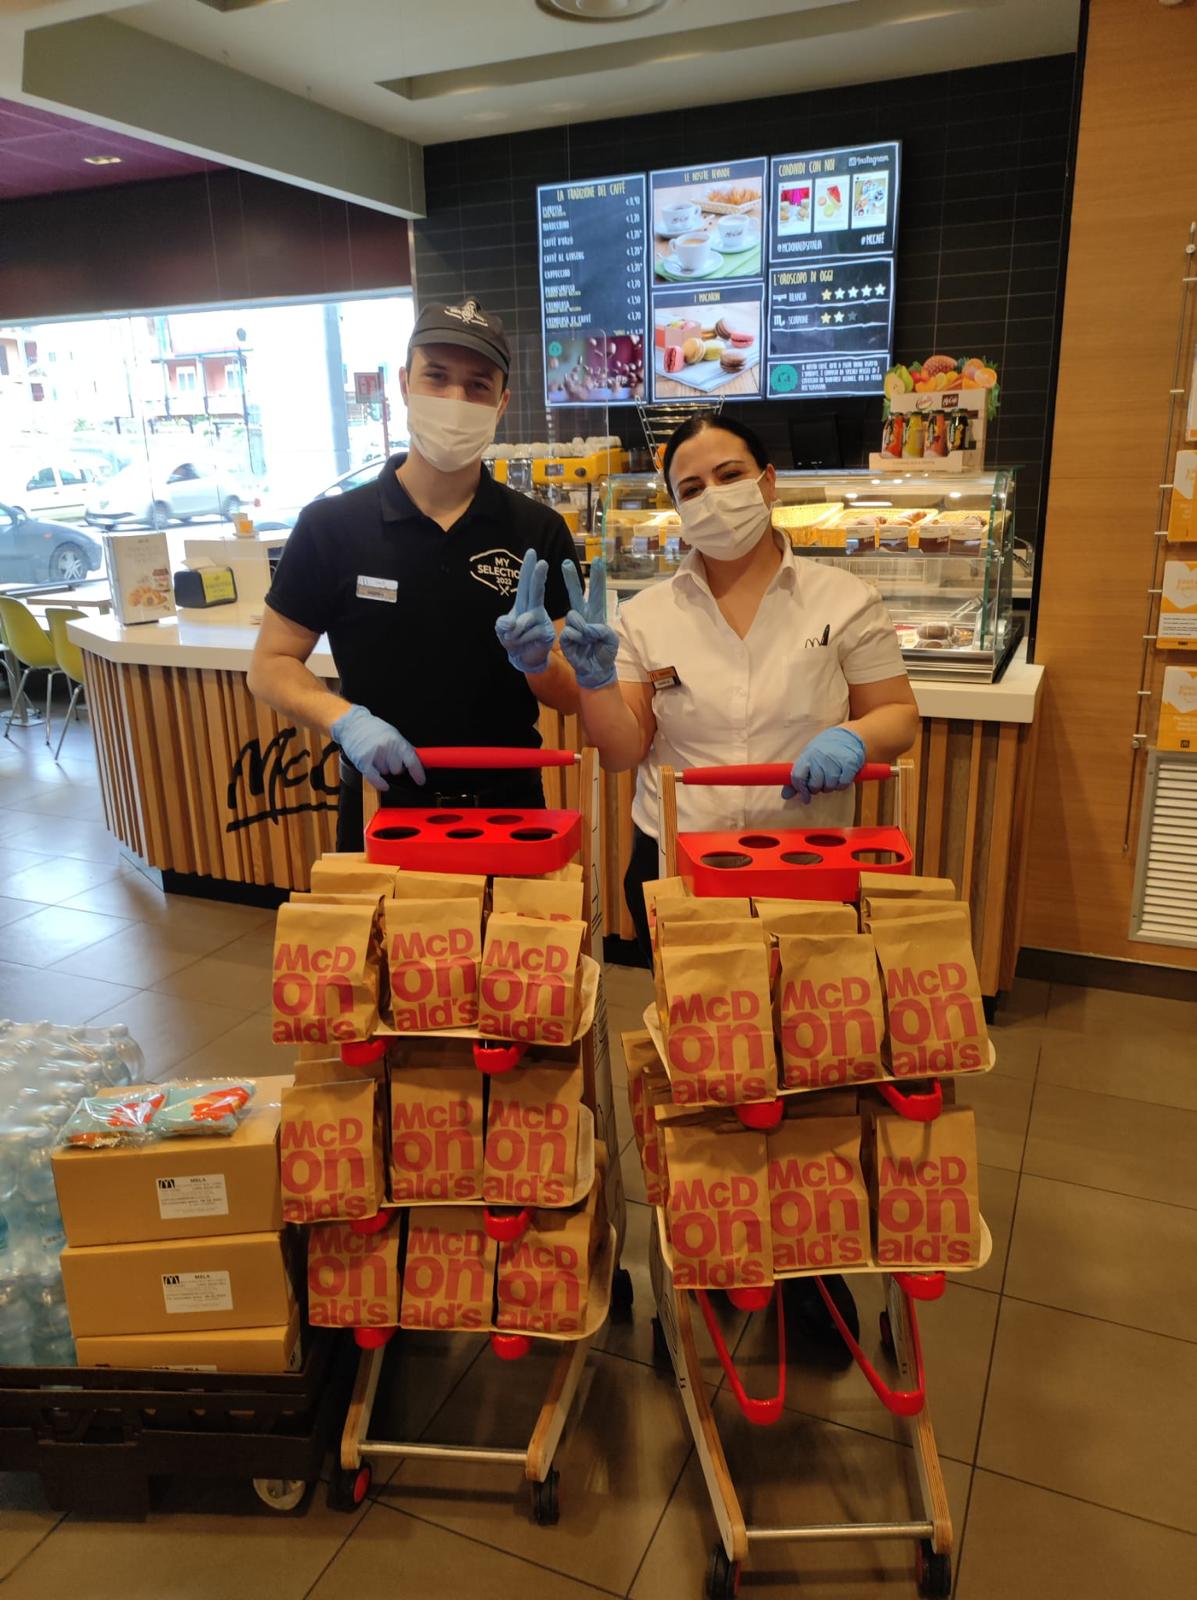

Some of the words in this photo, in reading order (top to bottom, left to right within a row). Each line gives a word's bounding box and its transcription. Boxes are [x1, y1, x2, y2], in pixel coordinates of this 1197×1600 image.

[778, 162, 806, 177] CONDIVIDI
[808, 160, 822, 174] CON
[824, 158, 836, 172] NOI
[857, 155, 889, 167] Instagram
[557, 189, 564, 202] LA
[597, 184, 607, 197] DEL
[609, 181, 626, 196] CAFFÈ
[774, 271, 808, 287] L'OROSCOPO
[810, 270, 817, 283] DI
[819, 269, 834, 282] OGGI
[477, 564, 520, 580] SELECTIO
[494, 557, 510, 567] MY
[274, 943, 356, 973] McD
[390, 928, 474, 959] McD
[485, 940, 568, 972] McD
[273, 973, 355, 1016] on
[392, 956, 477, 1002] on
[481, 969, 567, 1016] on
[782, 977, 871, 1010] McD
[888, 963, 967, 996] McD
[397, 998, 478, 1032] ald's
[670, 990, 759, 1022] McD
[890, 992, 976, 1045] on
[274, 1018, 355, 1044] ald's
[480, 1013, 564, 1044] ald's
[782, 1008, 877, 1059] on
[668, 1022, 765, 1073] on
[894, 1040, 981, 1076] ald's
[785, 1057, 876, 1088] ald's
[673, 1073, 767, 1104] ald's
[393, 1100, 473, 1130] McD
[489, 1100, 568, 1130] McD
[281, 1118, 363, 1149] McD
[395, 1126, 474, 1171] on
[486, 1128, 567, 1173] on
[282, 1147, 365, 1193] on
[769, 1156, 853, 1189] McD
[880, 1156, 967, 1187] McD
[394, 1172, 475, 1200] ald's
[483, 1173, 564, 1203] ald's
[673, 1176, 758, 1211] McD
[284, 1193, 366, 1222] ald's
[770, 1187, 858, 1238] on
[879, 1187, 971, 1233] on
[310, 1226, 389, 1255] McD
[408, 1227, 486, 1257] McD
[672, 1209, 763, 1258] on
[879, 1234, 970, 1264] ald's
[500, 1240, 578, 1270] McD
[774, 1234, 862, 1267] ald's
[309, 1254, 387, 1296] on
[404, 1256, 483, 1301] on
[673, 1256, 764, 1288] ald's
[500, 1270, 580, 1312] on
[310, 1300, 389, 1326] ald's
[401, 1298, 482, 1328] ald's
[500, 1306, 577, 1331] ald's
